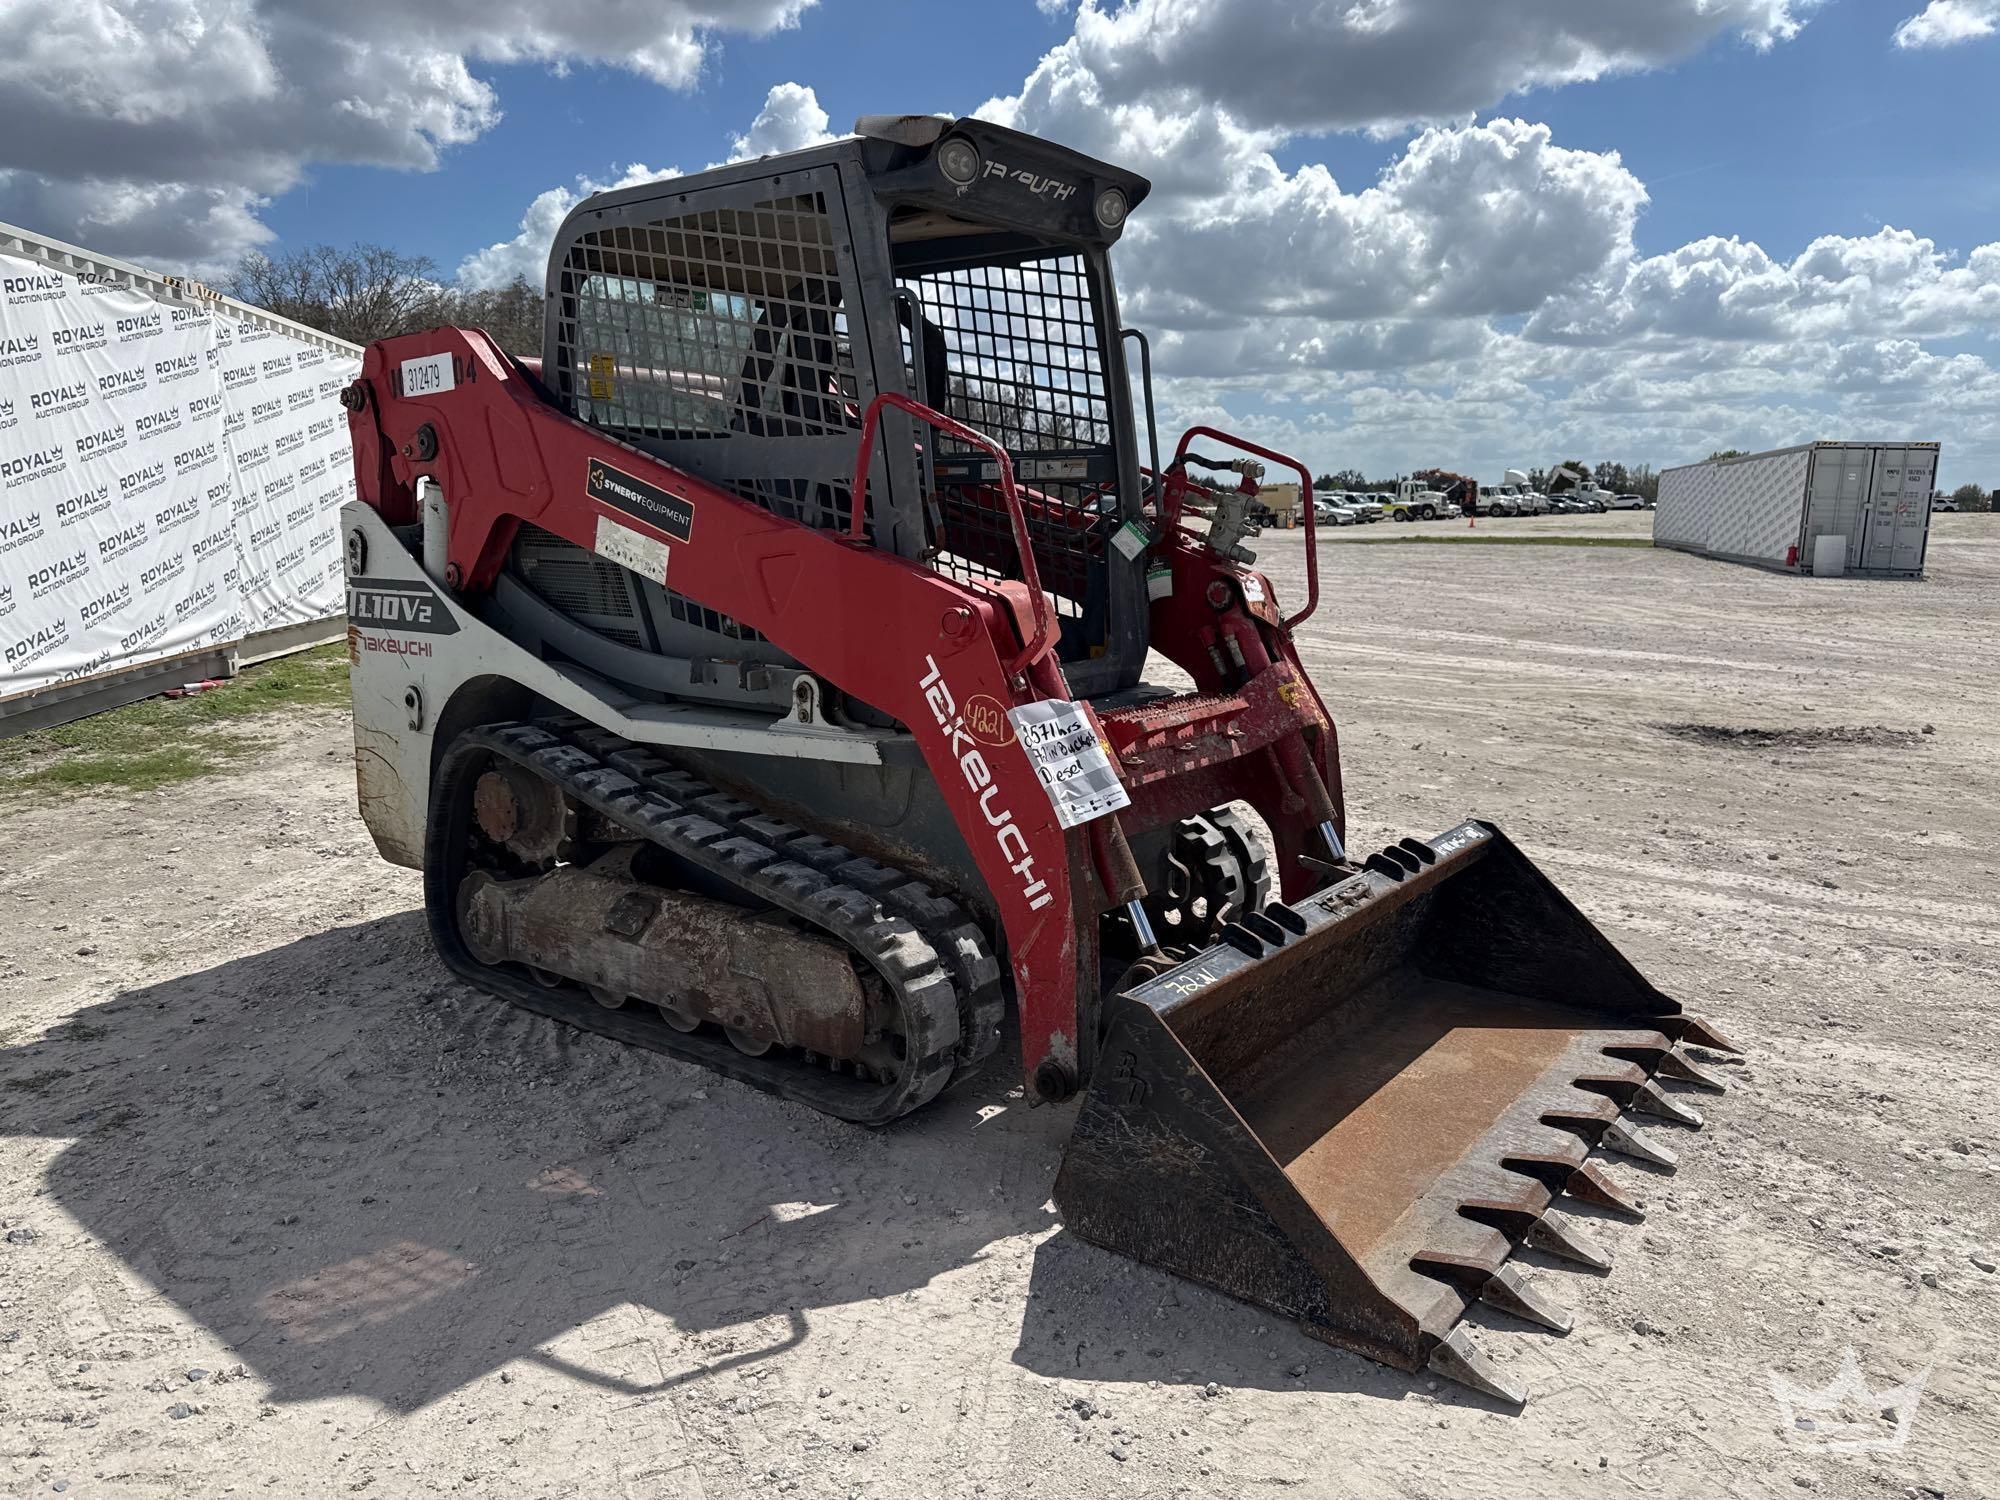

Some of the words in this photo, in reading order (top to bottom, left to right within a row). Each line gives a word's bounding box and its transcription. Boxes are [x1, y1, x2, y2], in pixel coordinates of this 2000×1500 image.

[4, 276, 52, 293] ROYAL
[81, 287, 107, 296] AUCTION
[109, 283, 131, 292] GROUP
[9, 294, 42, 305] AUCTION
[43, 291, 66, 301] GROUP
[116, 315, 152, 333] ROYAL
[171, 307, 204, 322] ROYAL
[52, 326, 95, 345] ROYAL
[120, 331, 144, 343] AUCTION
[144, 328, 163, 338] GROUP
[174, 321, 197, 331] AUCTION
[15, 353, 42, 364] GROUP
[57, 345, 85, 356] AUCTION
[86, 340, 107, 351] GROUP
[155, 356, 189, 375] ROYAL
[159, 372, 182, 384] AUCTION
[182, 367, 200, 378] GROUP
[224, 367, 250, 382] ROYAL
[263, 358, 285, 372] ROYAL
[98, 370, 136, 390] ROYAL
[408, 364, 440, 391] 312479
[31, 385, 77, 408] ROYAL
[102, 387, 128, 400] AUCTION
[128, 382, 147, 393] GROUP
[35, 405, 67, 420] AUCTION
[67, 399, 90, 411] GROUP
[189, 395, 219, 414] ROYAL
[252, 401, 276, 417] ROYAL
[135, 411, 171, 432] ROYAL
[192, 411, 213, 423] AUCTION
[76, 429, 116, 453] ROYAL
[139, 427, 163, 441] AUCTION
[163, 421, 182, 432] GROUP
[276, 434, 298, 449] ROYAL
[80, 448, 107, 463] AUCTION
[108, 440, 128, 452] GROUP
[174, 447, 207, 467] ROYAL
[237, 447, 262, 465] ROYAL
[0, 451, 53, 478] ROYAL
[177, 463, 201, 476] AUCTION
[201, 455, 218, 466] GROUP
[6, 471, 40, 489] AUCTION
[41, 463, 67, 477] GROUP
[120, 467, 156, 491] ROYAL
[264, 478, 288, 495] ROYAL
[123, 484, 148, 500] AUCTION
[148, 476, 166, 489] GROUP
[56, 491, 99, 517] ROYAL
[60, 511, 90, 528] AUCTION
[90, 500, 112, 515] GROUP
[156, 501, 190, 526] ROYAL
[159, 520, 182, 535] AUCTION
[182, 510, 200, 522] GROUP
[17, 529, 45, 546] GROUP
[98, 528, 137, 555] ROYAL
[192, 532, 225, 555] ROYAL
[251, 525, 274, 545] ROYAL
[102, 547, 129, 564] AUCTION
[129, 536, 148, 550] GROUP
[197, 549, 217, 563] AUCTION
[217, 539, 233, 552] GROUP
[276, 552, 298, 571] ROYAL
[28, 557, 77, 589] ROYAL
[33, 579, 65, 600] AUCTION
[66, 566, 90, 584] GROUP
[140, 559, 175, 586] ROYAL
[144, 576, 167, 595] AUCTION
[167, 566, 185, 580] GROUP
[239, 574, 263, 593] ROYAL
[80, 590, 121, 621] ROYAL
[175, 589, 207, 615] ROYAL
[178, 606, 200, 624] AUCTION
[200, 594, 217, 609] GROUP
[263, 601, 287, 621] ROYAL
[85, 609, 112, 631] AUCTION
[112, 597, 133, 614] GROUP
[121, 621, 158, 651] ROYAL
[151, 627, 168, 643] GROUP
[210, 612, 241, 639] ROYAL
[5, 627, 55, 663] ROYAL
[12, 648, 44, 673] AUCTION
[44, 634, 70, 654] GROUP
[967, 703, 1005, 742] 4221
